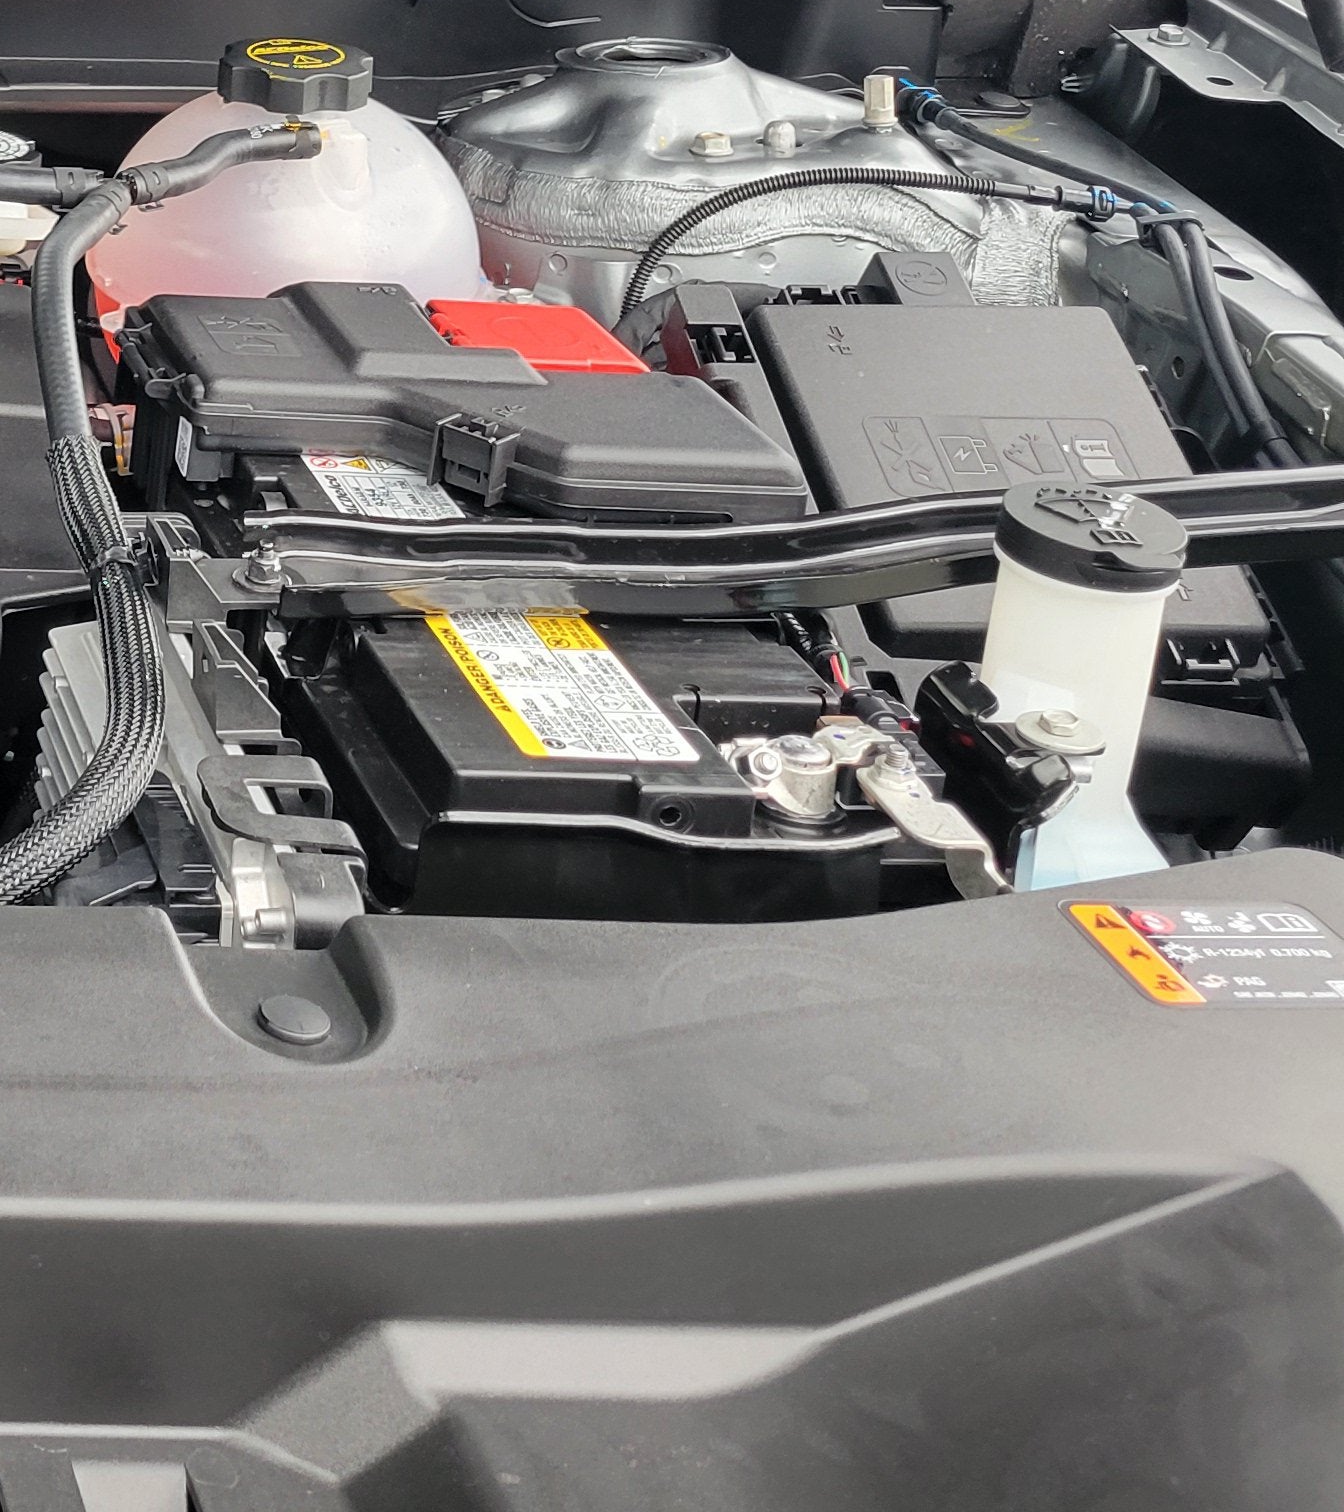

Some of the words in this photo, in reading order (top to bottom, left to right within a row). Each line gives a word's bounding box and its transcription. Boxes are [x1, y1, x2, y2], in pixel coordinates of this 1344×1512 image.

[1192, 925, 1225, 933] AUTO
[1270, 948, 1311, 958] 0.700
[1233, 976, 1267, 986] PAG
